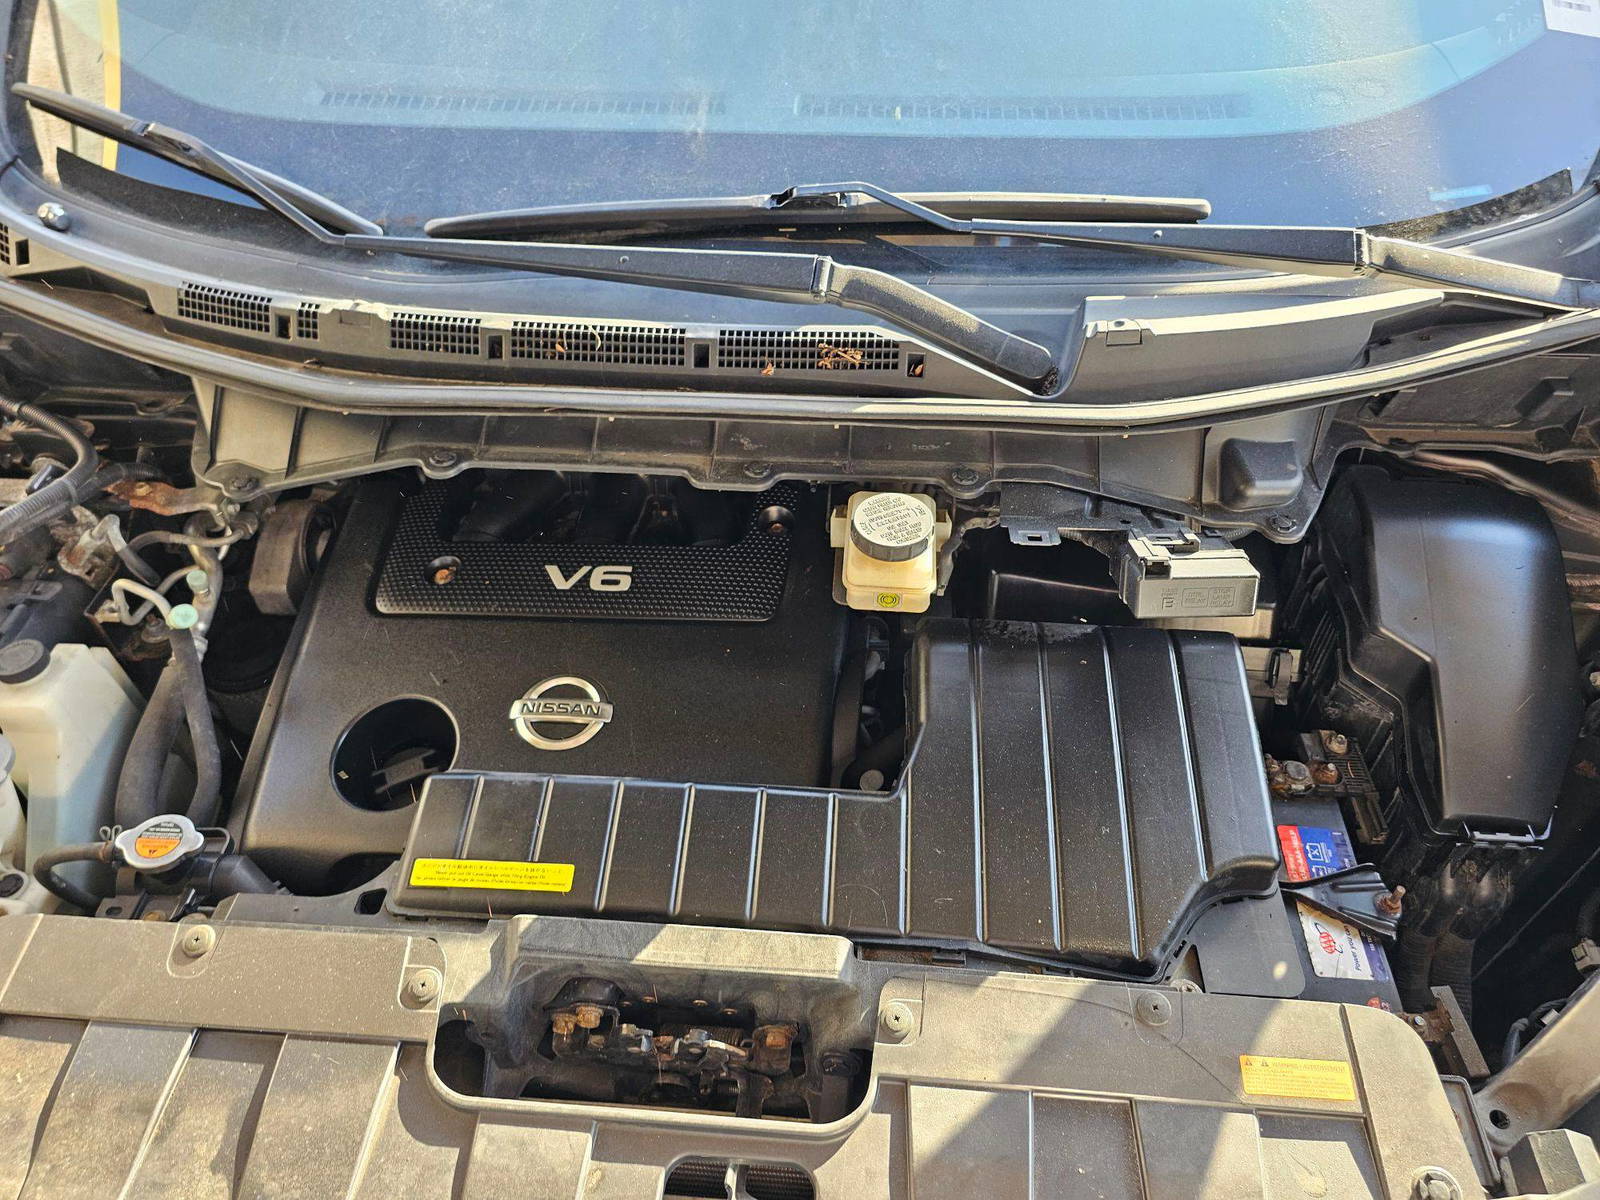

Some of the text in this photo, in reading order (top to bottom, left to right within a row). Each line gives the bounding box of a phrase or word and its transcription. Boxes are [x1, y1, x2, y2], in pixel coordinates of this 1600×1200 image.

[544, 565, 632, 592] V6
[521, 702, 600, 716] NISSAN
[1320, 932, 1336, 954] AAA
[1348, 938, 1356, 951] you
[1351, 950, 1362, 972] Power
